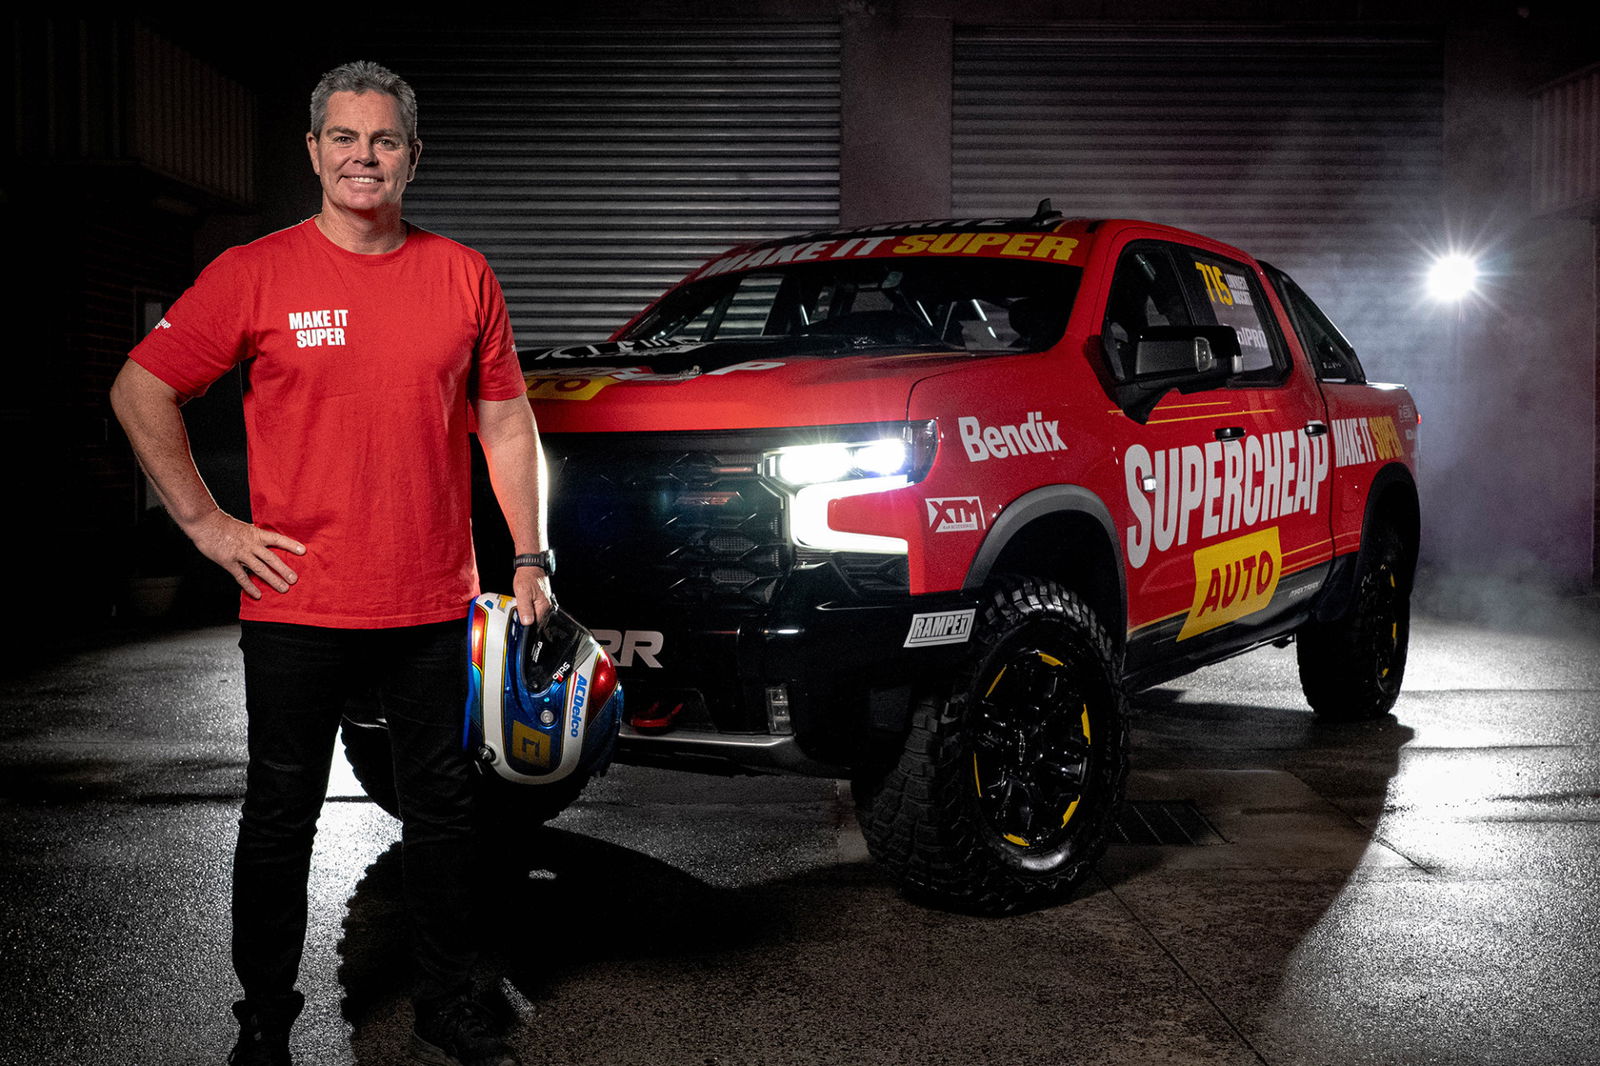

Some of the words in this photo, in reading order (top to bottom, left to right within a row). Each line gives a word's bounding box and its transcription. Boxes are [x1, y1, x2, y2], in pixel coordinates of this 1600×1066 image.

[695, 240, 828, 281] MAKE
[833, 236, 896, 257] IT
[892, 233, 1079, 262] SUPER
[1195, 261, 1233, 306] 715
[288, 310, 332, 330] MAKE
[334, 309, 349, 327] IT
[296, 328, 346, 348] SUPER
[958, 411, 1068, 463] Bendix
[929, 499, 981, 531] XTM
[1124, 420, 1329, 569] SUPERCHEAP
[1196, 550, 1274, 618] AUTO
[911, 612, 968, 639] RAMPEX
[570, 673, 588, 738] ACDelco
